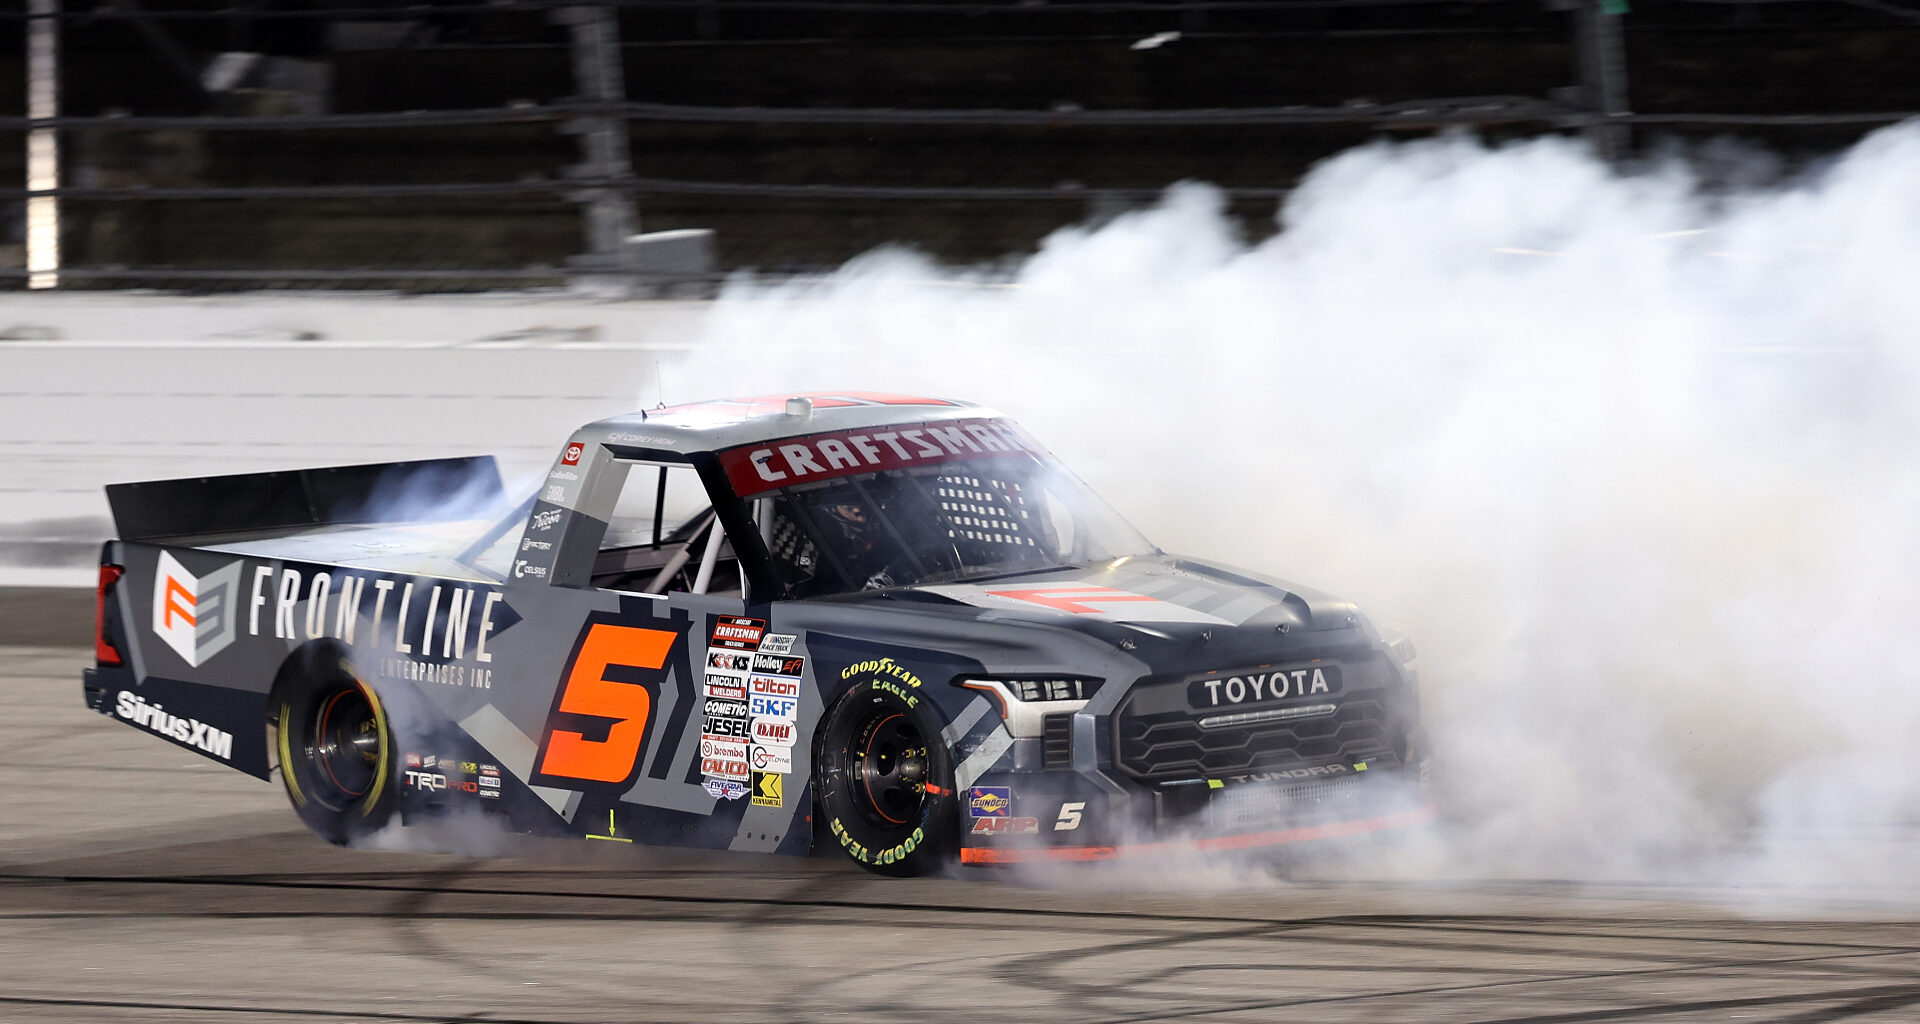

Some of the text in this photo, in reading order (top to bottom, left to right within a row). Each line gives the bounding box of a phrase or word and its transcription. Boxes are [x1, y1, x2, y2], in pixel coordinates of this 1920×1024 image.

[524, 565, 546, 575] CELSIUS
[248, 565, 503, 663] FRONTLINE
[715, 626, 760, 640] CRAFTSMAN
[708, 652, 750, 671] KOOKS
[754, 654, 783, 674] Holley
[380, 658, 492, 689] ENTERPRISES INC
[706, 675, 740, 687] LINCOLN
[712, 688, 742, 698] WELDERS
[753, 677, 796, 695] tilton
[872, 679, 919, 709] EAGLE
[1204, 668, 1329, 706] TOYOTA
[540, 623, 678, 783] 5
[704, 701, 747, 716] COMETIC
[752, 698, 795, 716] SKF
[115, 690, 234, 760] SiriusXM
[702, 717, 750, 737] JESEL
[714, 745, 744, 758] brembo
[702, 758, 748, 776] CALICO
[1228, 764, 1347, 784] TUNDRA
[405, 770, 478, 793] TRD PRO
[710, 781, 726, 789] FIVE
[752, 797, 782, 807] KENNAMETAL
[972, 798, 1009, 808] SUNOCO
[1053, 801, 1086, 831] 5
